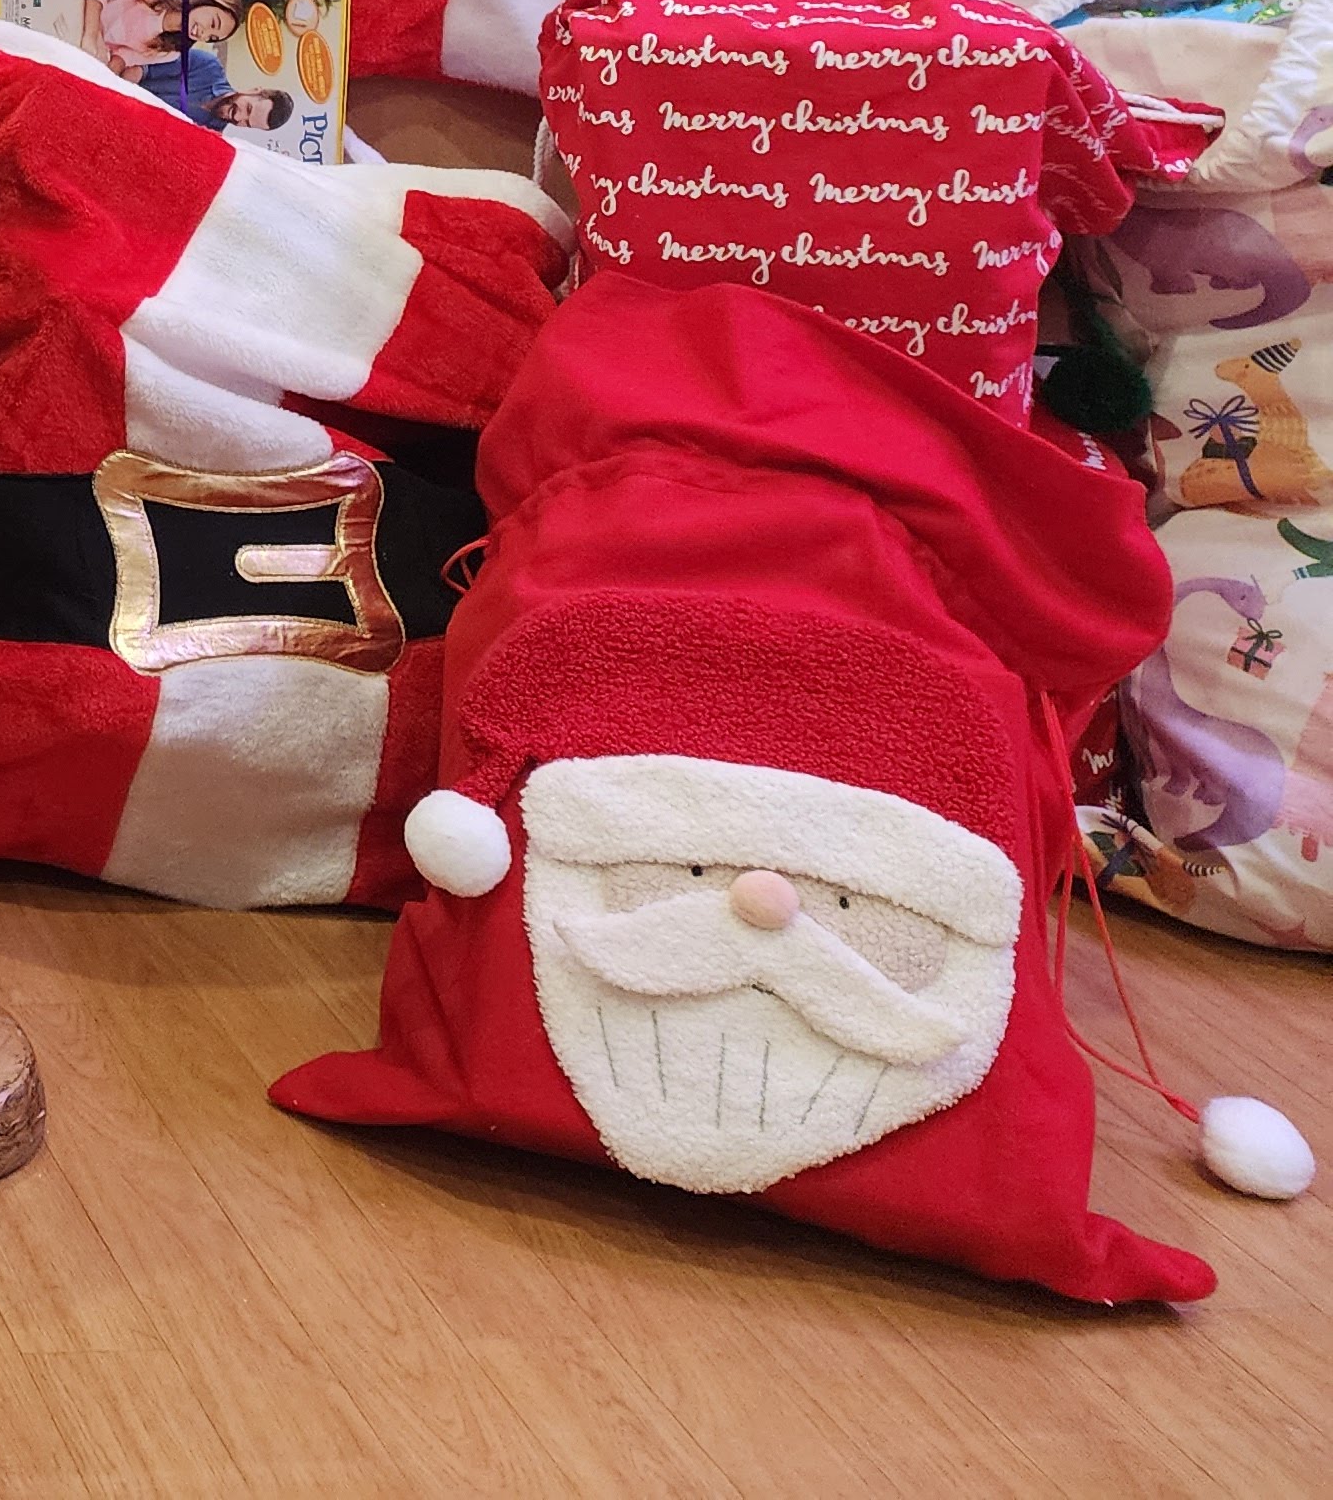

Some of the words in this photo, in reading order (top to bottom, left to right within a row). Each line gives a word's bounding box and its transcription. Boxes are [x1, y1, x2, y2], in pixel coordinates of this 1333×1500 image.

[627, 32, 790, 76] christmas
[781, 99, 950, 142] christmas
[627, 162, 790, 208] christmas
[780, 231, 950, 276] christmas
